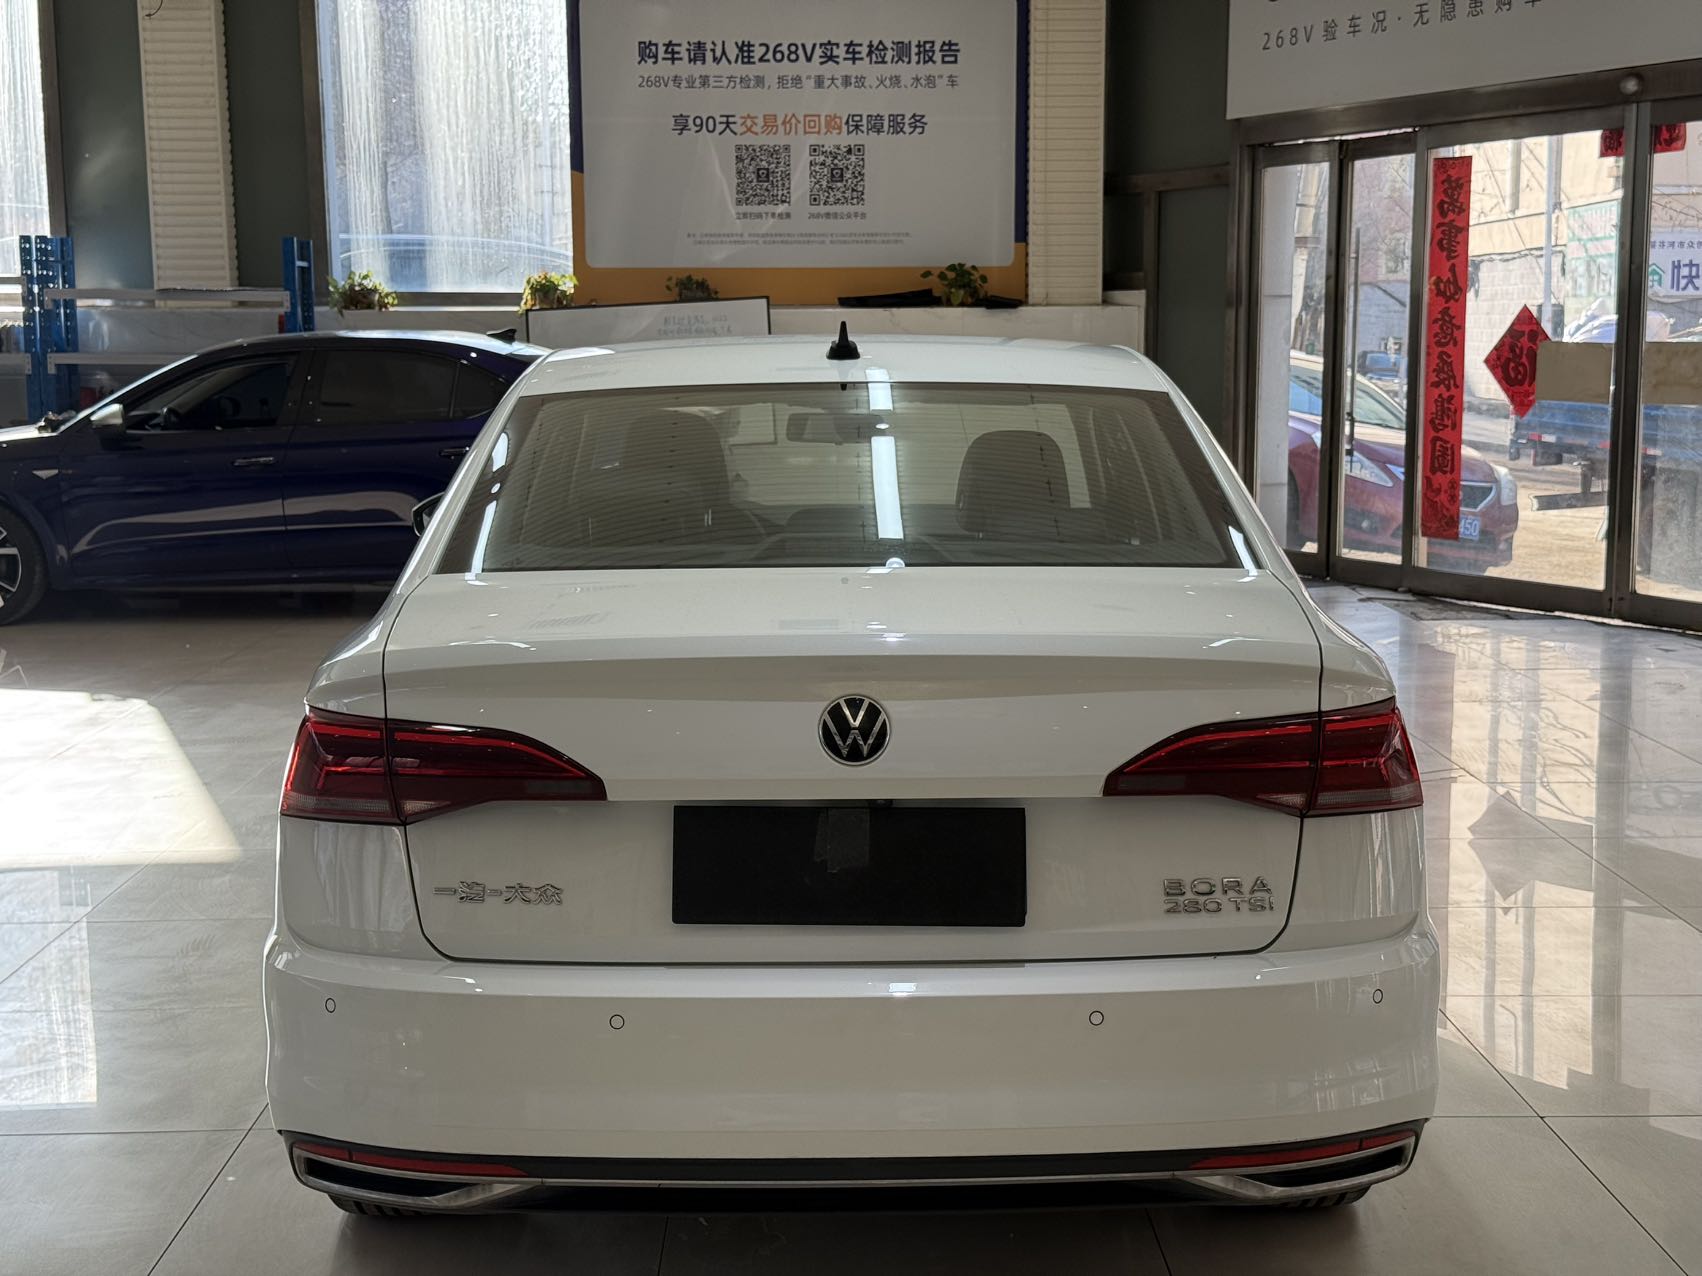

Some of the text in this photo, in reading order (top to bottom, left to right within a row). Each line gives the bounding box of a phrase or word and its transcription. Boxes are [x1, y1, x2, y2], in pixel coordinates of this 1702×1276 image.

[1262, 0, 1542, 50] 268V验车况·无隐患购
[637, 40, 961, 66] 购车请认准268V实车检测报告
[671, 113, 929, 137] 享90天交易价回购保障服务
[1671, 259, 1700, 291] 快
[1163, 876, 1273, 897] BORA
[1163, 897, 1223, 914] 280
